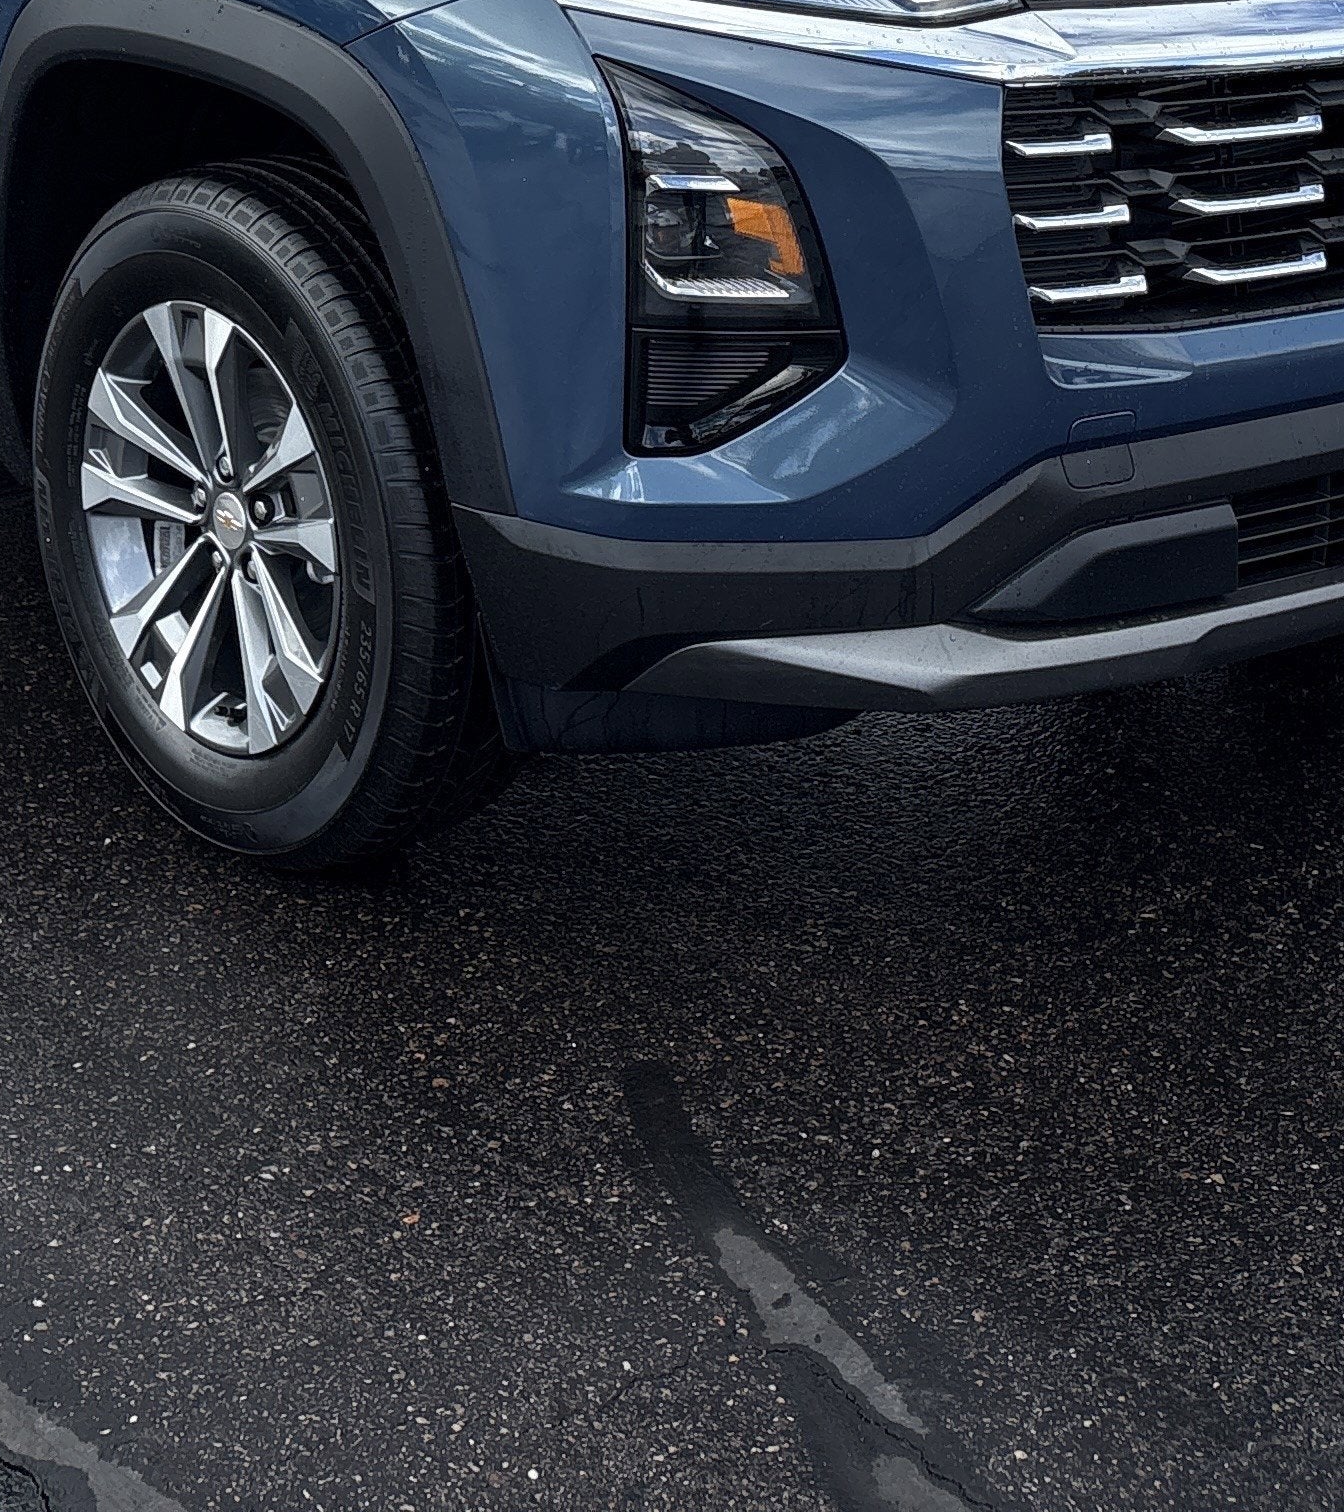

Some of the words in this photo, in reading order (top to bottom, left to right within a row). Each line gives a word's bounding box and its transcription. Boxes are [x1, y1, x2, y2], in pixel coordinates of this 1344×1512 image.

[318, 399, 373, 592] MICHELIN
[353, 619, 373, 699] 235/65
[343, 719, 356, 743] 17
